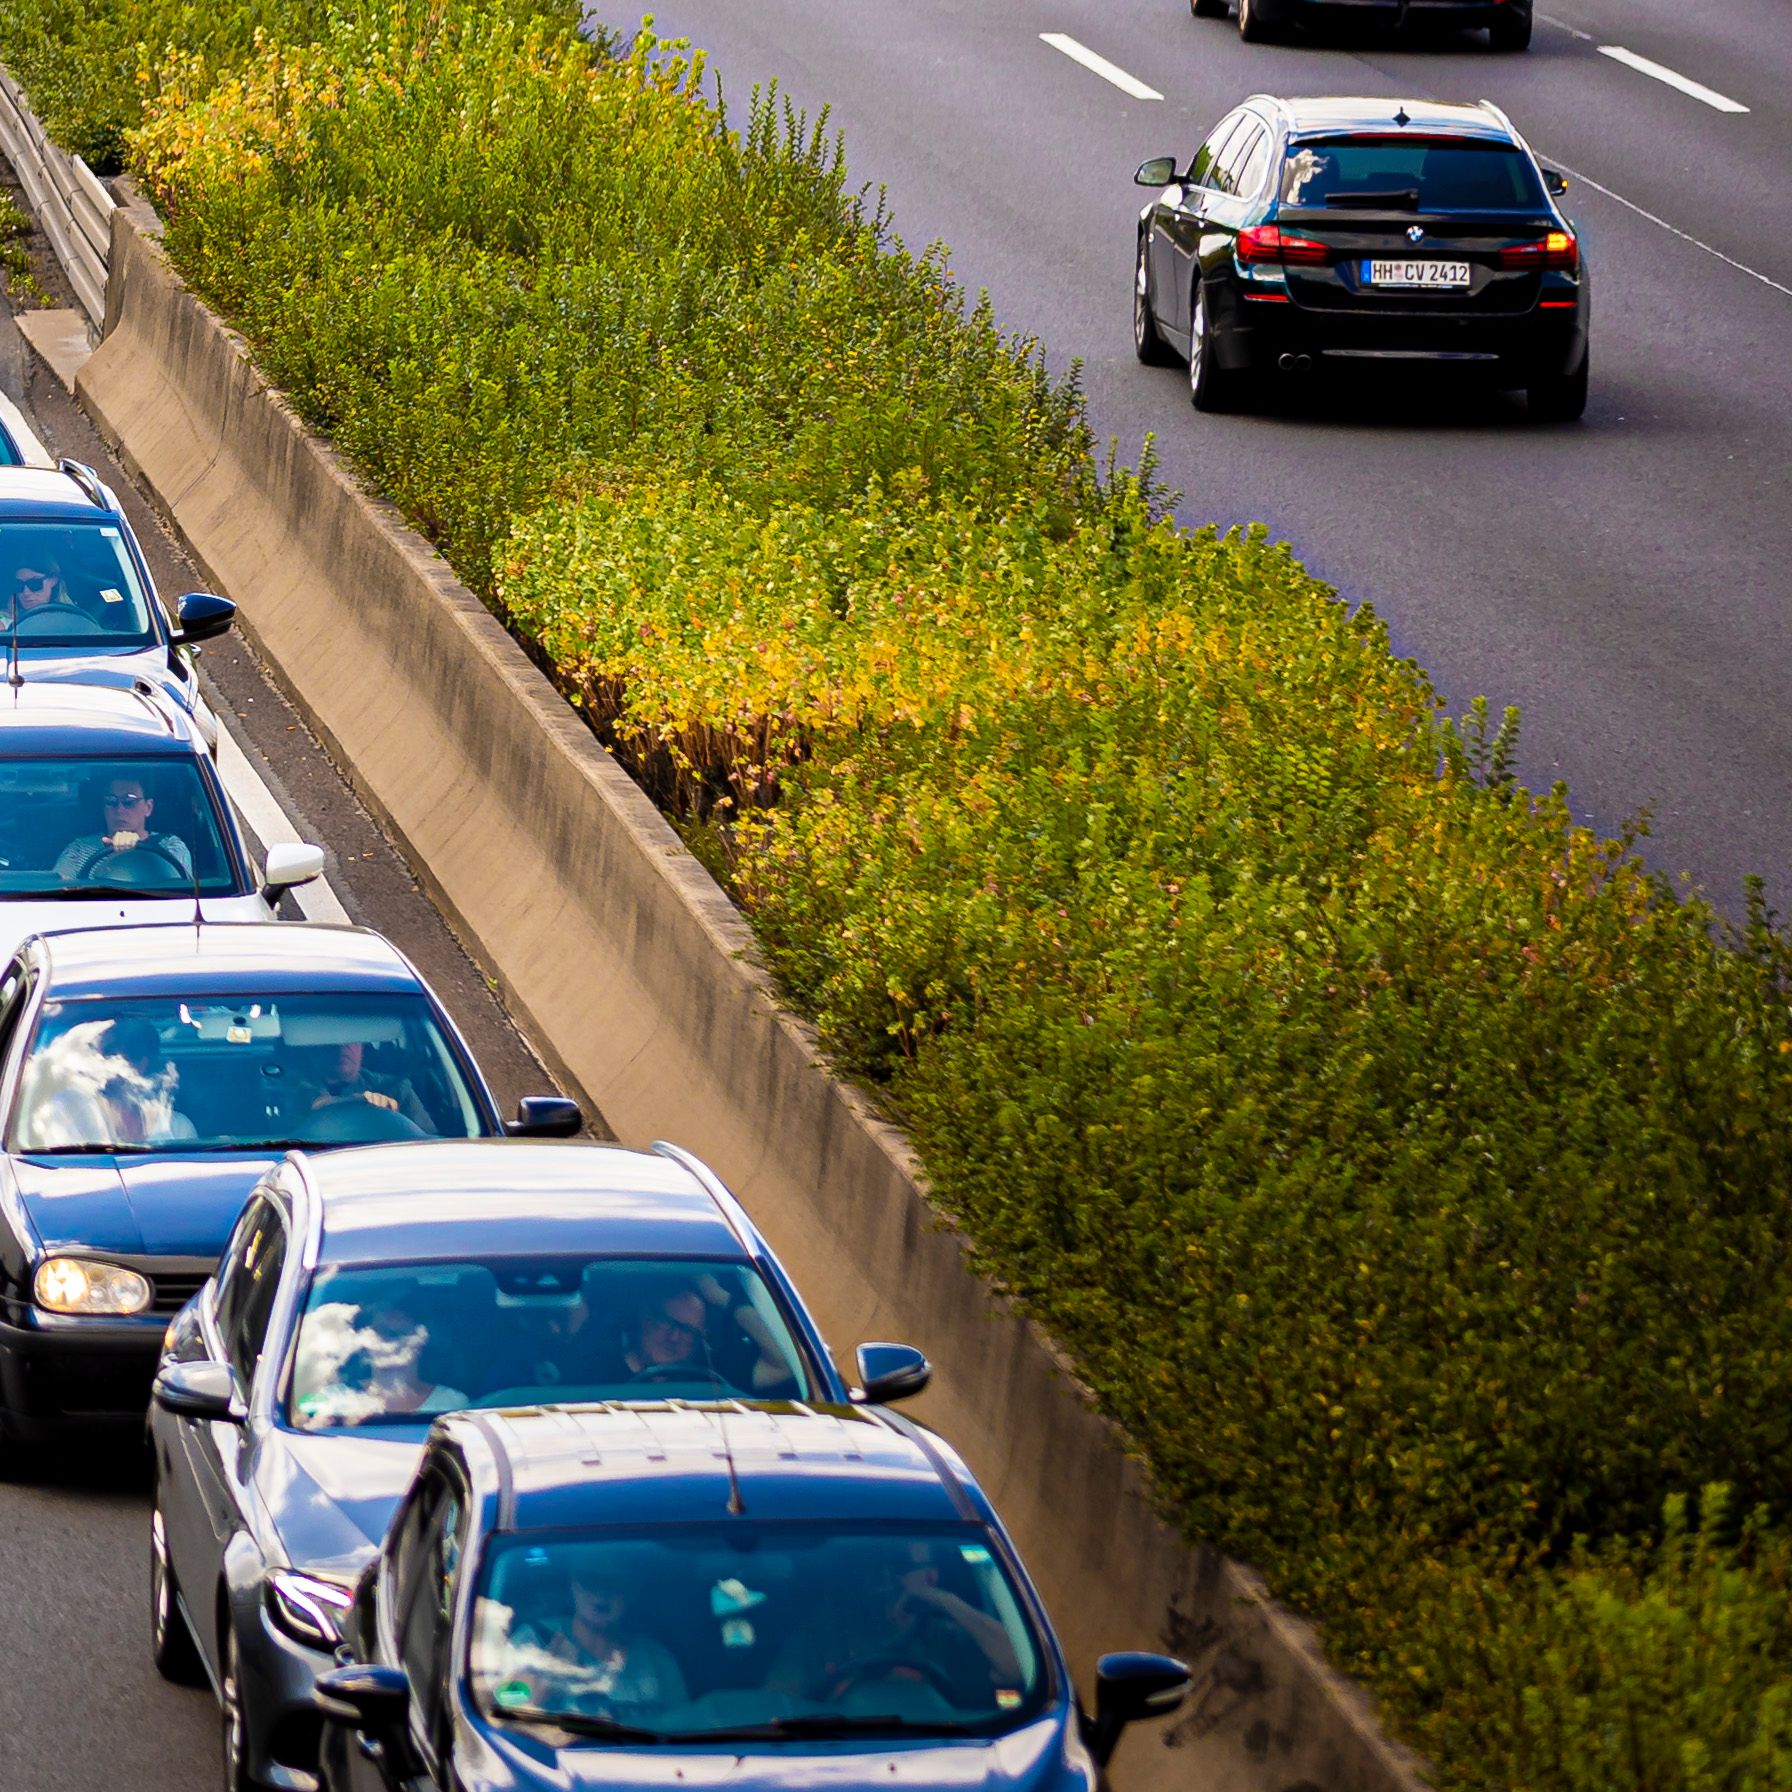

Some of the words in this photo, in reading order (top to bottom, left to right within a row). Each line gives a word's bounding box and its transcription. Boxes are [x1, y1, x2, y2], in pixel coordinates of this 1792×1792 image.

[1372, 263, 1393, 281] HH
[1404, 263, 1426, 282] CV
[1429, 264, 1469, 283] 2412
